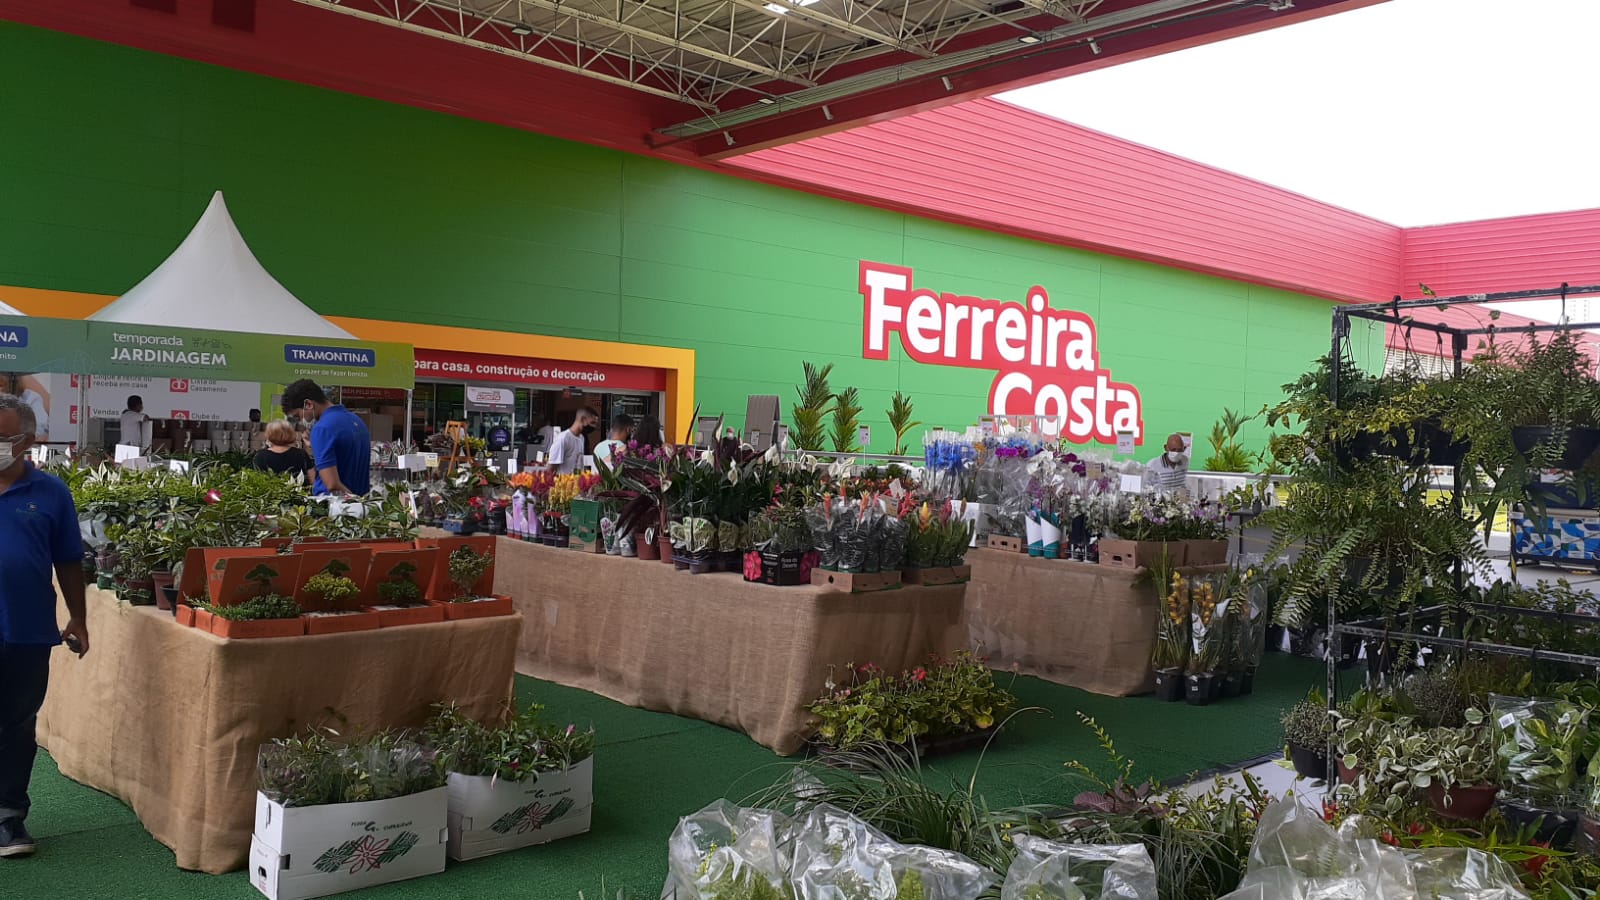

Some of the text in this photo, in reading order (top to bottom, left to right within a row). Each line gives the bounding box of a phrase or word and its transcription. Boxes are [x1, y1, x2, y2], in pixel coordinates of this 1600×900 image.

[866, 269, 1095, 371] Ferreira
[113, 332, 183, 346] temporada
[111, 347, 227, 366] JARDINAGEM
[291, 349, 369, 363] TRAMONTINA
[442, 361, 473, 374] casa,
[476, 364, 540, 378] construção
[542, 369, 549, 377] e
[551, 368, 606, 383] decoração
[190, 384, 228, 392] Casamento
[993, 372, 1139, 437] Costa
[93, 408, 120, 416] Vendas
[191, 412, 209, 420] Clube
